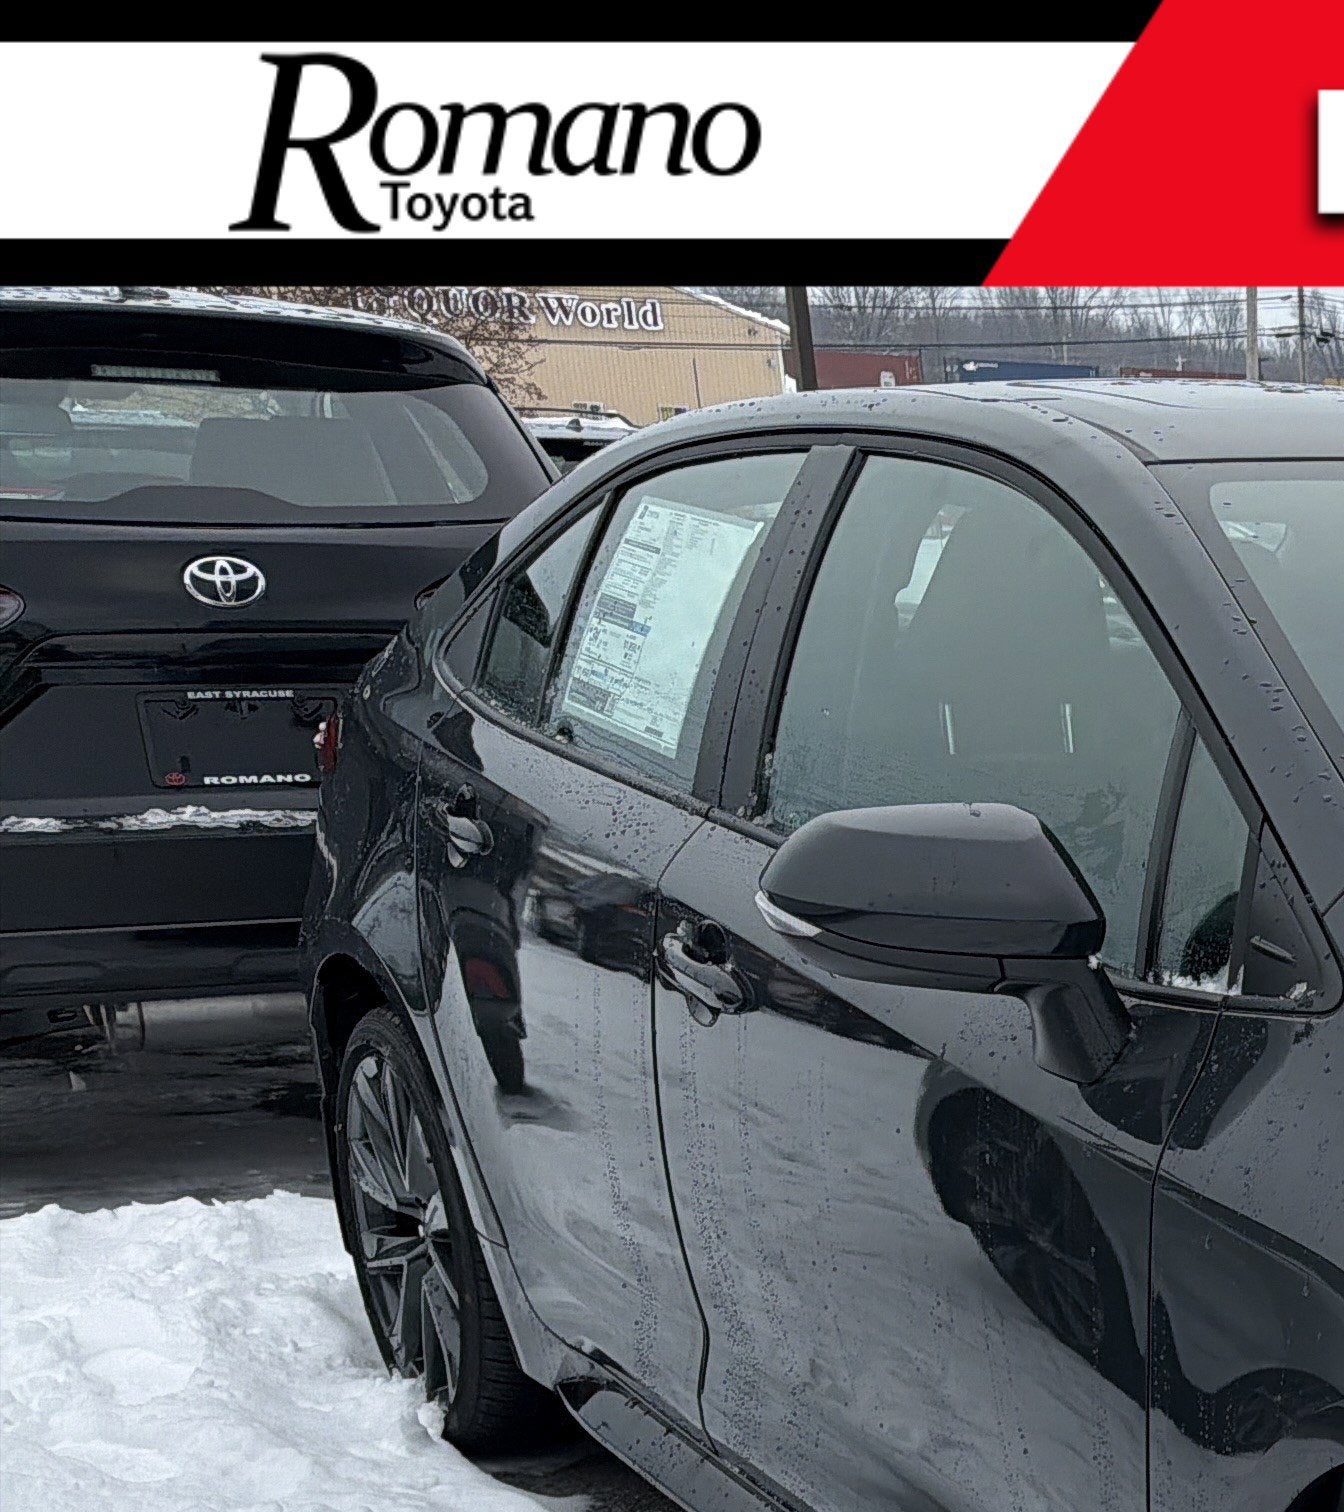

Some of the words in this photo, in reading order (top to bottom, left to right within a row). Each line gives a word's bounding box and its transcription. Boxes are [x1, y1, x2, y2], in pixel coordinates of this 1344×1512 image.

[353, 286, 535, 325] QUOR
[535, 292, 665, 331] World
[186, 690, 222, 700] EAST
[224, 689, 295, 699] SYRACUSE
[203, 773, 312, 785] ROMANO
